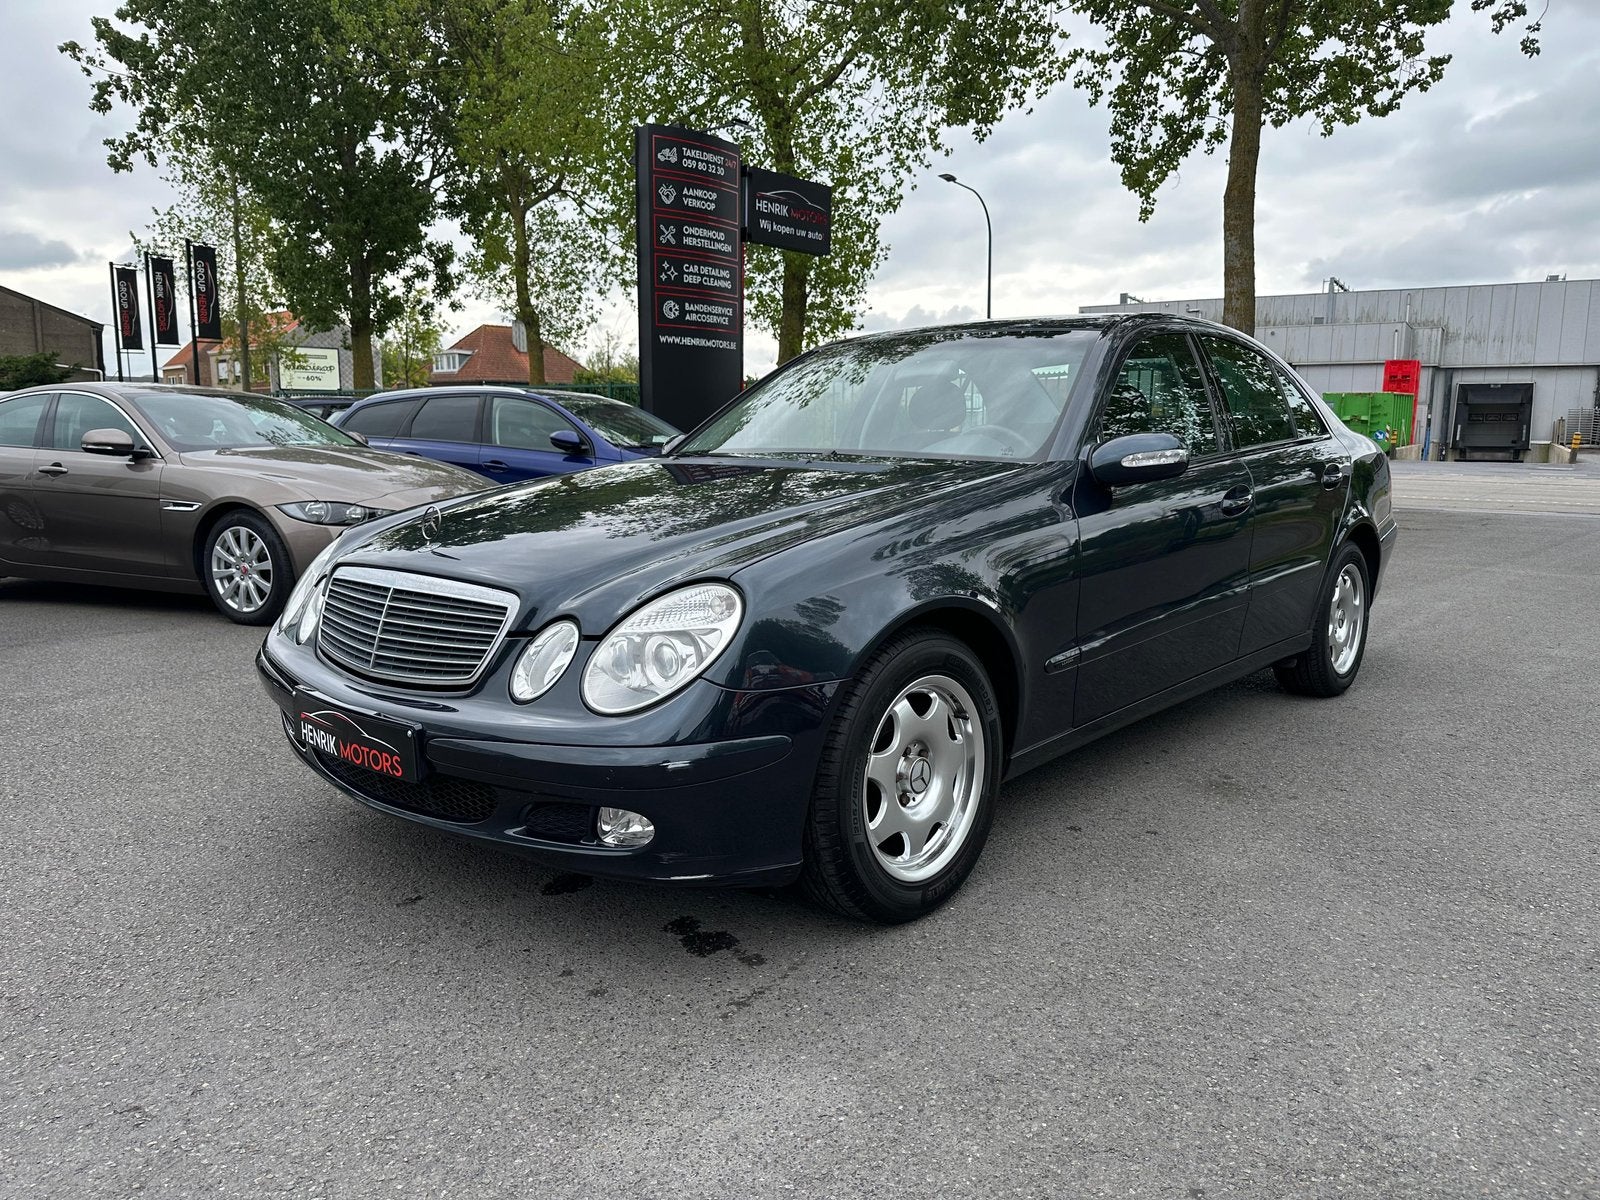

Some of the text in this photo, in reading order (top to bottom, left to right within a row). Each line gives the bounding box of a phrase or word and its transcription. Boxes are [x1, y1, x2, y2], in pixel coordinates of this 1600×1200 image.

[682, 147, 724, 165] TAKELDIENST
[682, 158, 725, 176] 059 80 32 30
[682, 186, 718, 201] AANKOOP
[682, 197, 716, 211] VERKOOP
[755, 198, 828, 225] HENRIK MOTORS
[683, 225, 725, 241] ONDERHOUD
[759, 218, 772, 232] Wij
[772, 221, 795, 235] kopen
[796, 229, 807, 237] uw
[683, 237, 732, 253] HERSTELLINGEN
[683, 263, 730, 279] CAR DETAILING
[683, 274, 732, 289] DEEP CLEANING
[196, 260, 209, 324] GROUP HENRIK
[119, 280, 131, 336] GROUP HENRIK
[155, 271, 167, 331] HENRIK MOTORS
[684, 302, 733, 316] BANDENSERVICE
[685, 313, 729, 325] AIRCOSERVICE
[658, 334, 737, 350] WWW.HENRIKMOTORS.BE
[300, 721, 403, 777] HENRIK MOTORS
